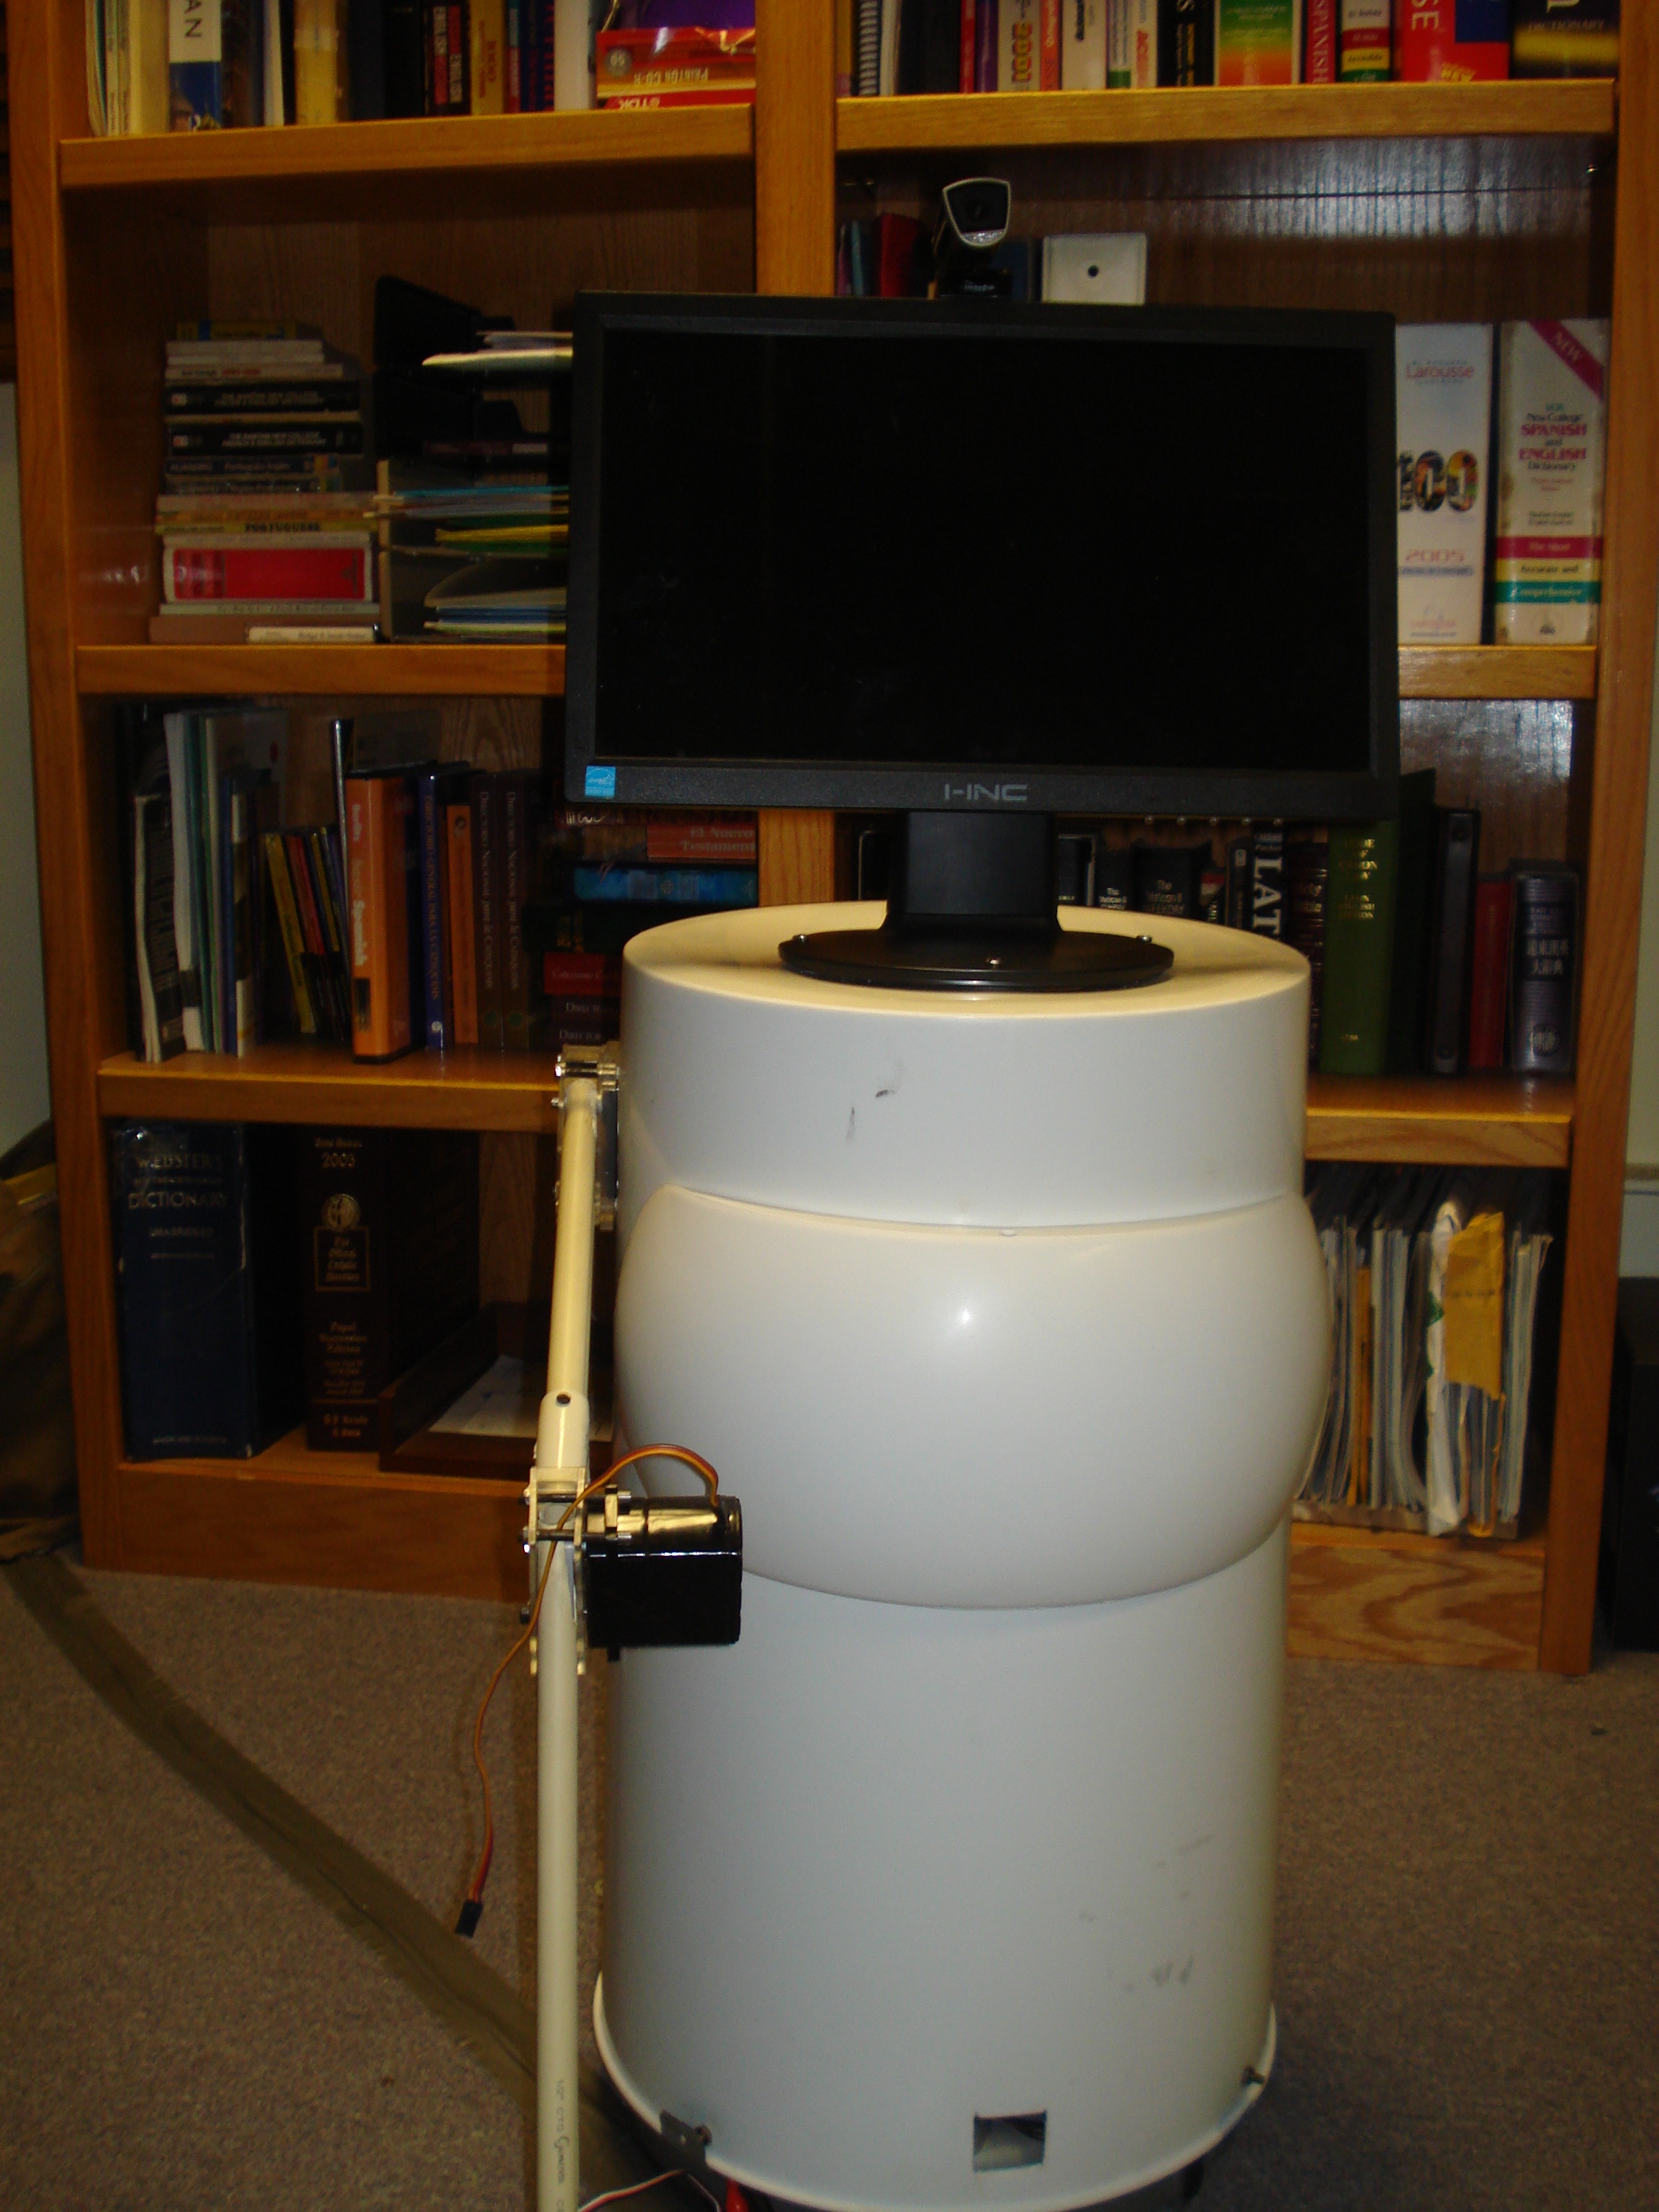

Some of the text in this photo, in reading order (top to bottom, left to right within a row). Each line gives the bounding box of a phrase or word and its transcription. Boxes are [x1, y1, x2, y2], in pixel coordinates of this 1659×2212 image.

[1405, 363, 1475, 379] Larousse
[1521, 423, 1587, 436] SPANISH
[1519, 447, 1587, 461] ENGLISH
[127, 1191, 229, 1210] DICTIONARY
